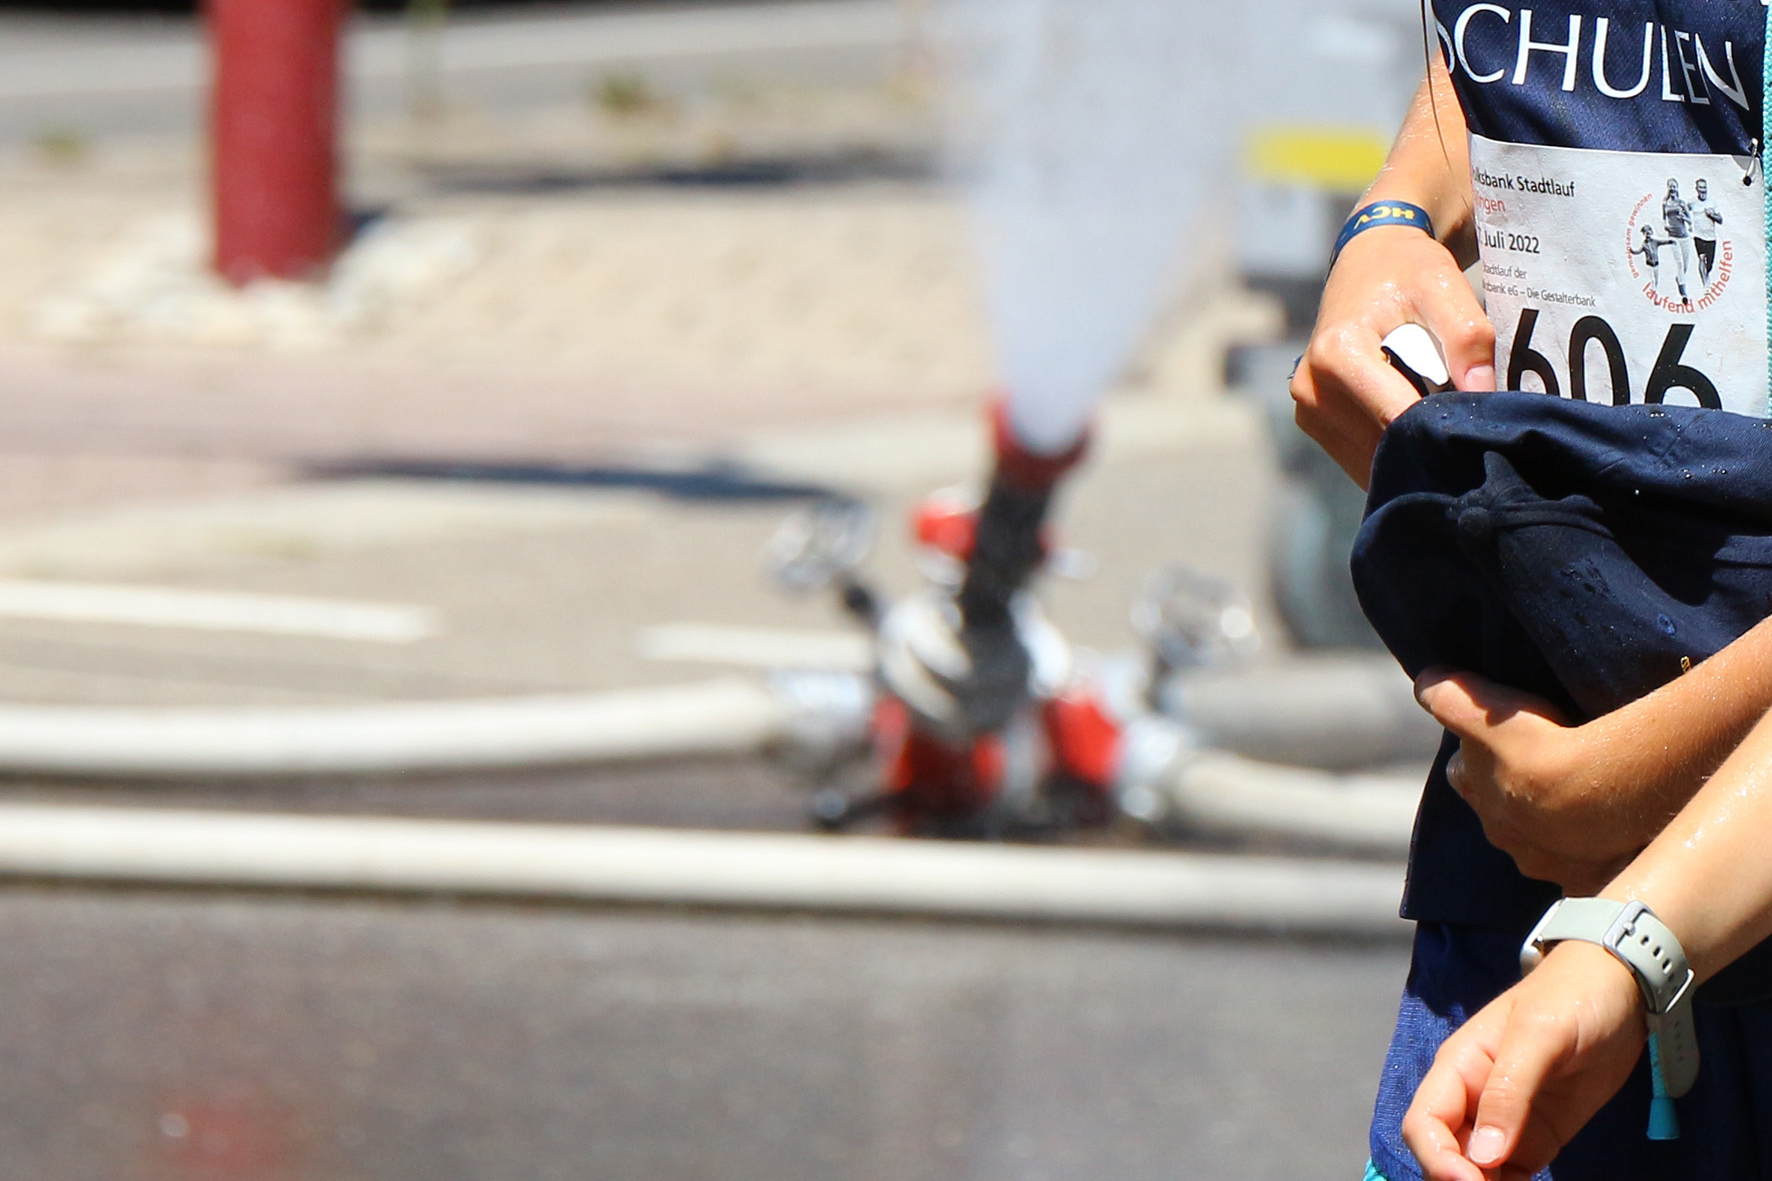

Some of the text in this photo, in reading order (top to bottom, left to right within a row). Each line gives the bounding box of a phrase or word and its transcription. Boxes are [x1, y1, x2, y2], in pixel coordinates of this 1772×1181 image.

[1516, 175, 1576, 198] Stadtlauf
[1628, 192, 1653, 227] gewinnen
[1484, 230, 1506, 249] Juli
[1508, 232, 1541, 255] 2022
[1513, 265, 1528, 280] der
[1642, 240, 1734, 315] laufend mithelfen
[1507, 284, 1519, 297] eG
[1526, 286, 1540, 300] Die
[1540, 289, 1598, 307] Gestalterbank
[1507, 307, 1723, 411] 606
